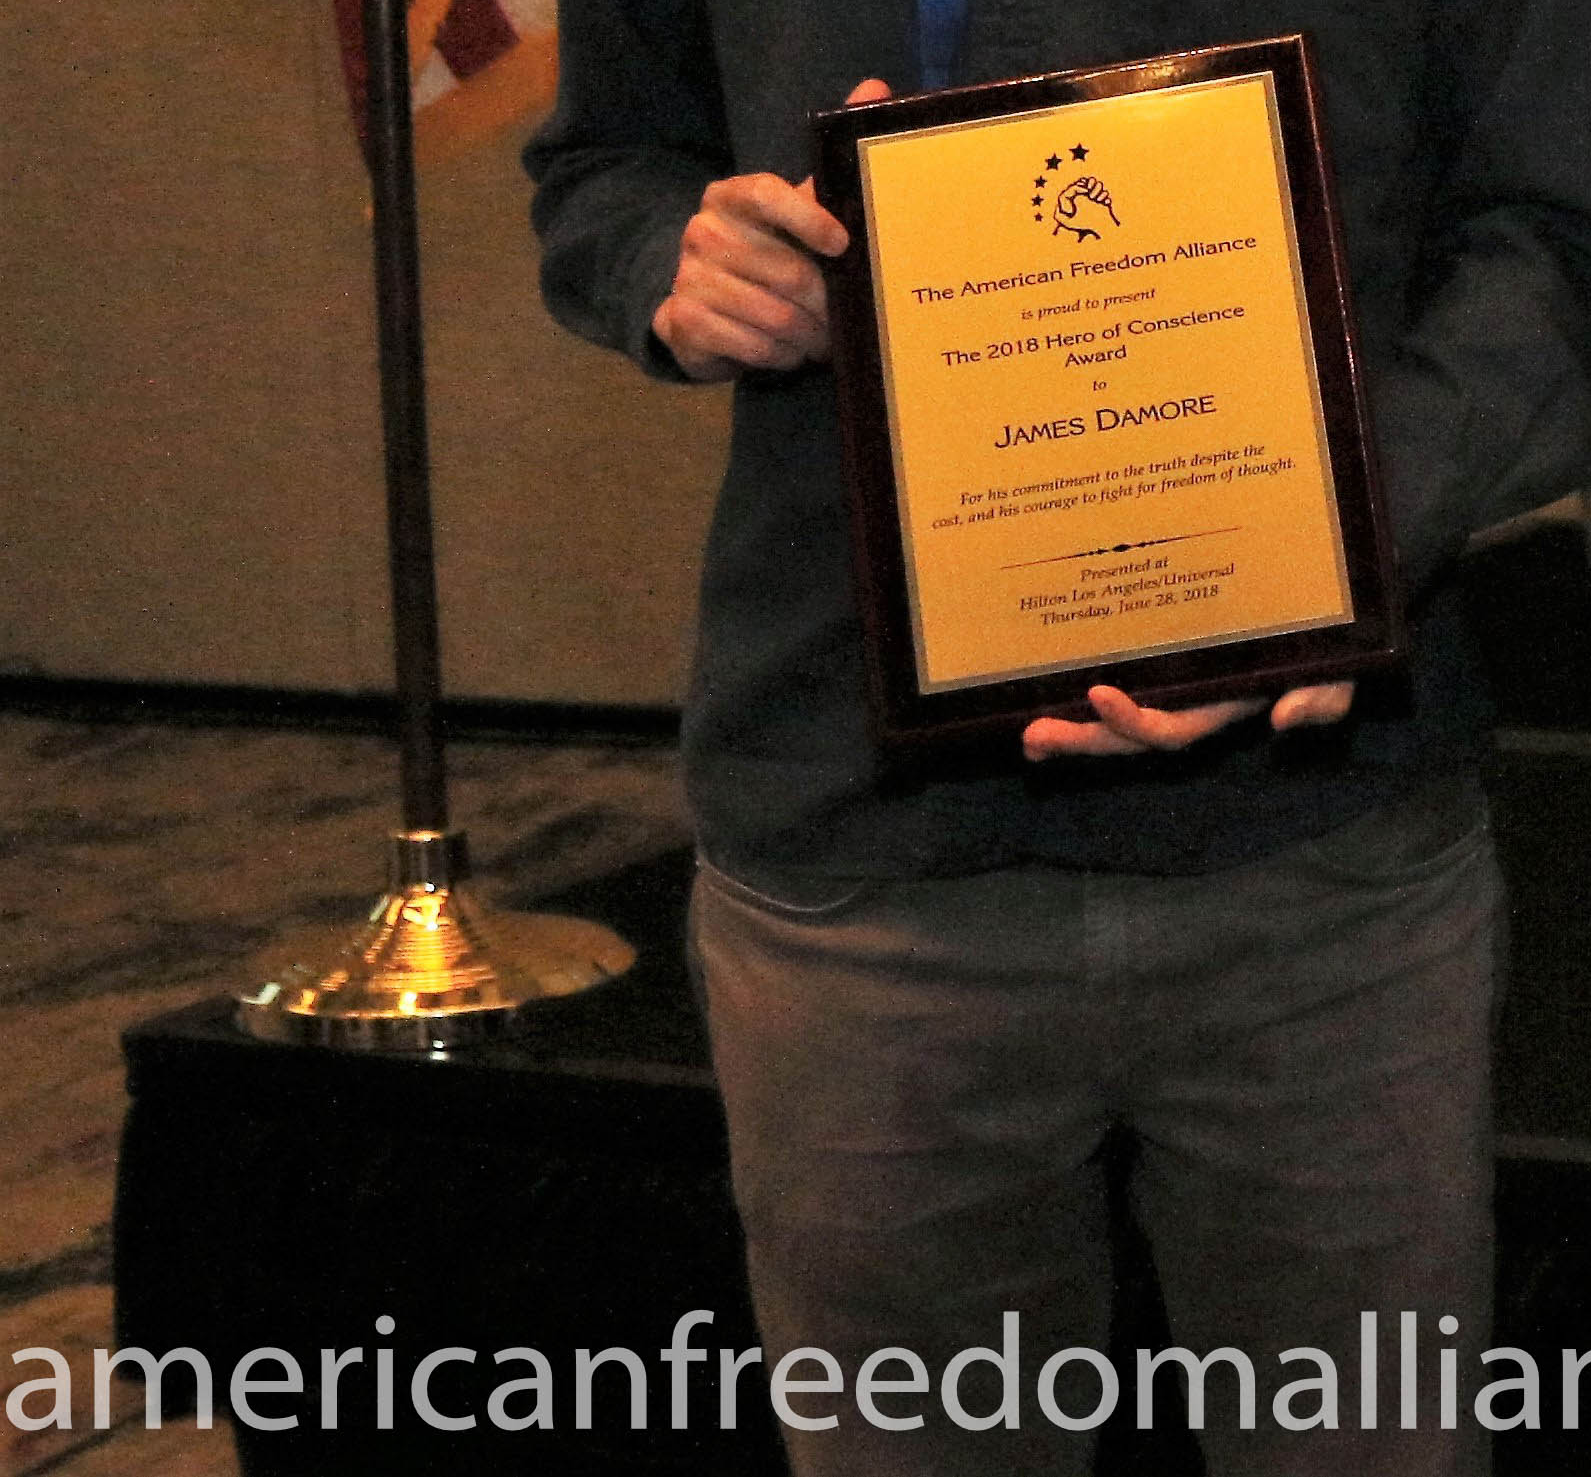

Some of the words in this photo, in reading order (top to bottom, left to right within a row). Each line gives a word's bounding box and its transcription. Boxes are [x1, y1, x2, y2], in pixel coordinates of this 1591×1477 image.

[911, 287, 954, 305] The
[960, 269, 1064, 297] American
[1069, 252, 1167, 278] Freedom
[1173, 237, 1257, 261] Alliance
[1021, 310, 1034, 320] is
[1037, 298, 1081, 322] proud
[1085, 298, 1100, 310] to
[1103, 287, 1156, 311] present
[940, 349, 981, 367] The
[986, 337, 1040, 360] 2018
[1045, 332, 1096, 350] Hero
[1101, 322, 1122, 340] of
[1127, 306, 1245, 335] Conscience
[1064, 344, 1127, 368] Award
[1092, 380, 1108, 392] to
[994, 417, 1086, 449] JAMES
[1095, 394, 1217, 432] DAMORE
[960, 491, 984, 506] For
[987, 488, 1008, 501] his
[1012, 472, 1101, 497] commitment
[1105, 470, 1120, 481] to
[1123, 464, 1145, 479] the
[1148, 456, 1186, 474] truth
[1190, 449, 1240, 467] despite
[1243, 444, 1265, 458] the
[967, 507, 995, 524] and
[998, 503, 1020, 517] his
[1023, 496, 1079, 514] courage
[1082, 492, 1097, 504] to
[1099, 484, 1133, 505] fight
[1135, 482, 1157, 499] for
[1160, 472, 1216, 494] freedom
[1220, 467, 1234, 484] of
[1019, 594, 1068, 612] Hilton
[1072, 588, 1096, 602] Los
[1101, 562, 1235, 598] Angeles/Universal
[1080, 558, 1151, 583] Presented
[1154, 555, 1169, 570] at
[1118, 599, 1152, 615] June
[1183, 584, 1219, 602] 2018
